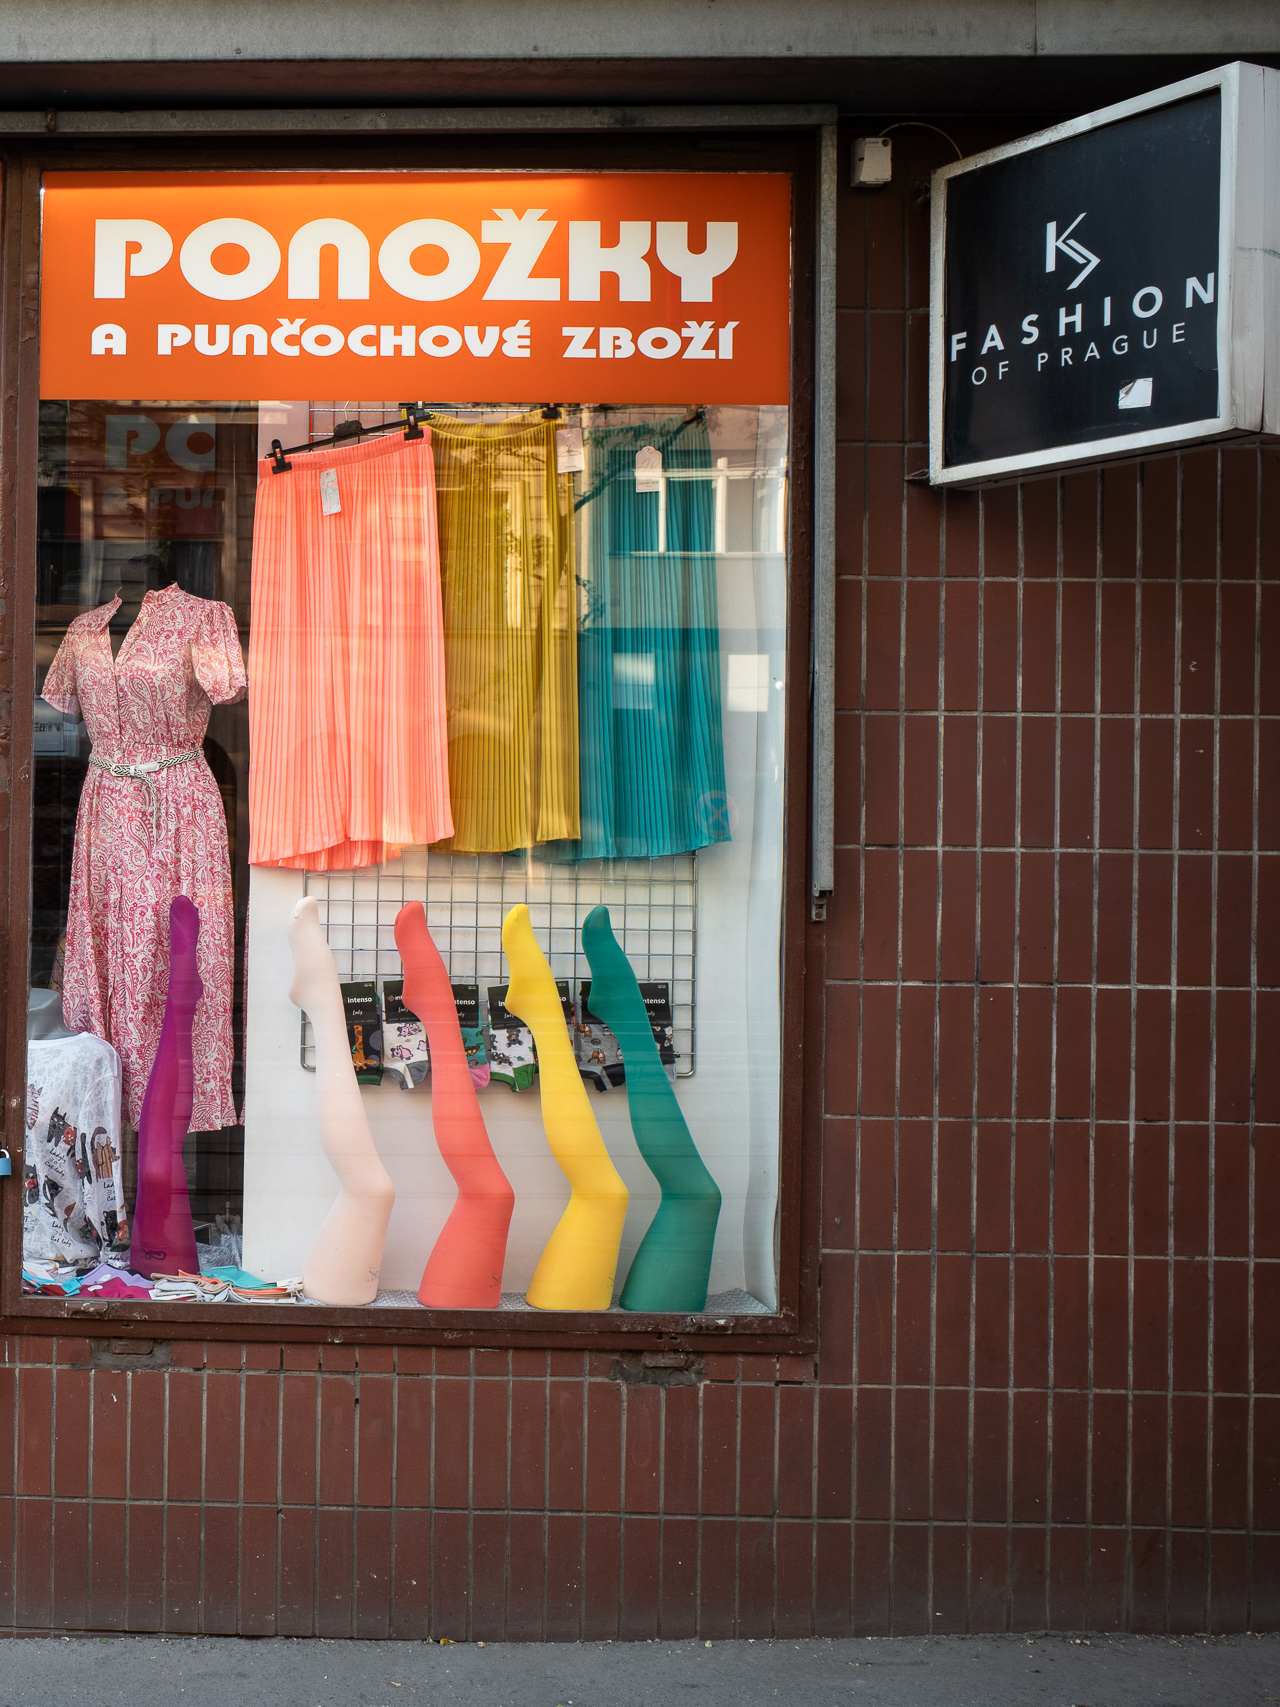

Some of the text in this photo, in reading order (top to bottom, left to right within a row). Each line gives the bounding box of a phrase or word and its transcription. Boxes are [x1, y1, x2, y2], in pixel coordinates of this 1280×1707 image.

[94, 208, 738, 302] PONOŽKY
[91, 318, 740, 360] A PUNČOCHOVÉ ZBOŽÍ
[950, 272, 1216, 362] FASHION
[971, 321, 1187, 387] OF PRAGUE
